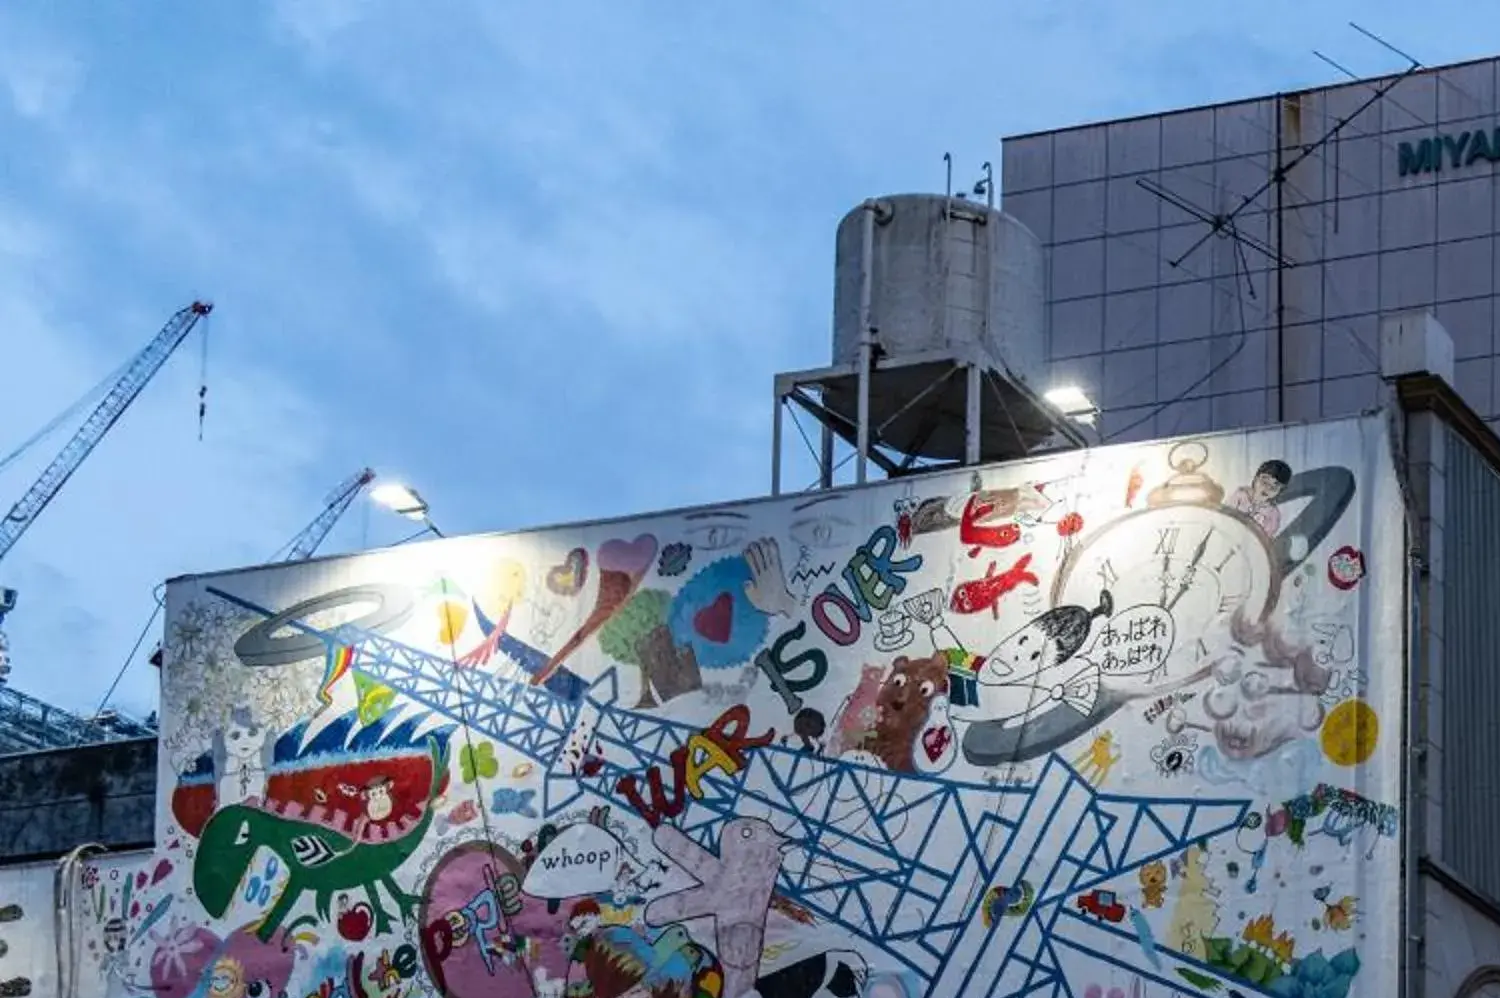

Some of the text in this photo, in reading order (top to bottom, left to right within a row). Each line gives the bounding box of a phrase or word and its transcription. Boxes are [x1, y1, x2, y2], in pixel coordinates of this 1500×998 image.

[616, 525, 923, 828] WAR IS OVER
